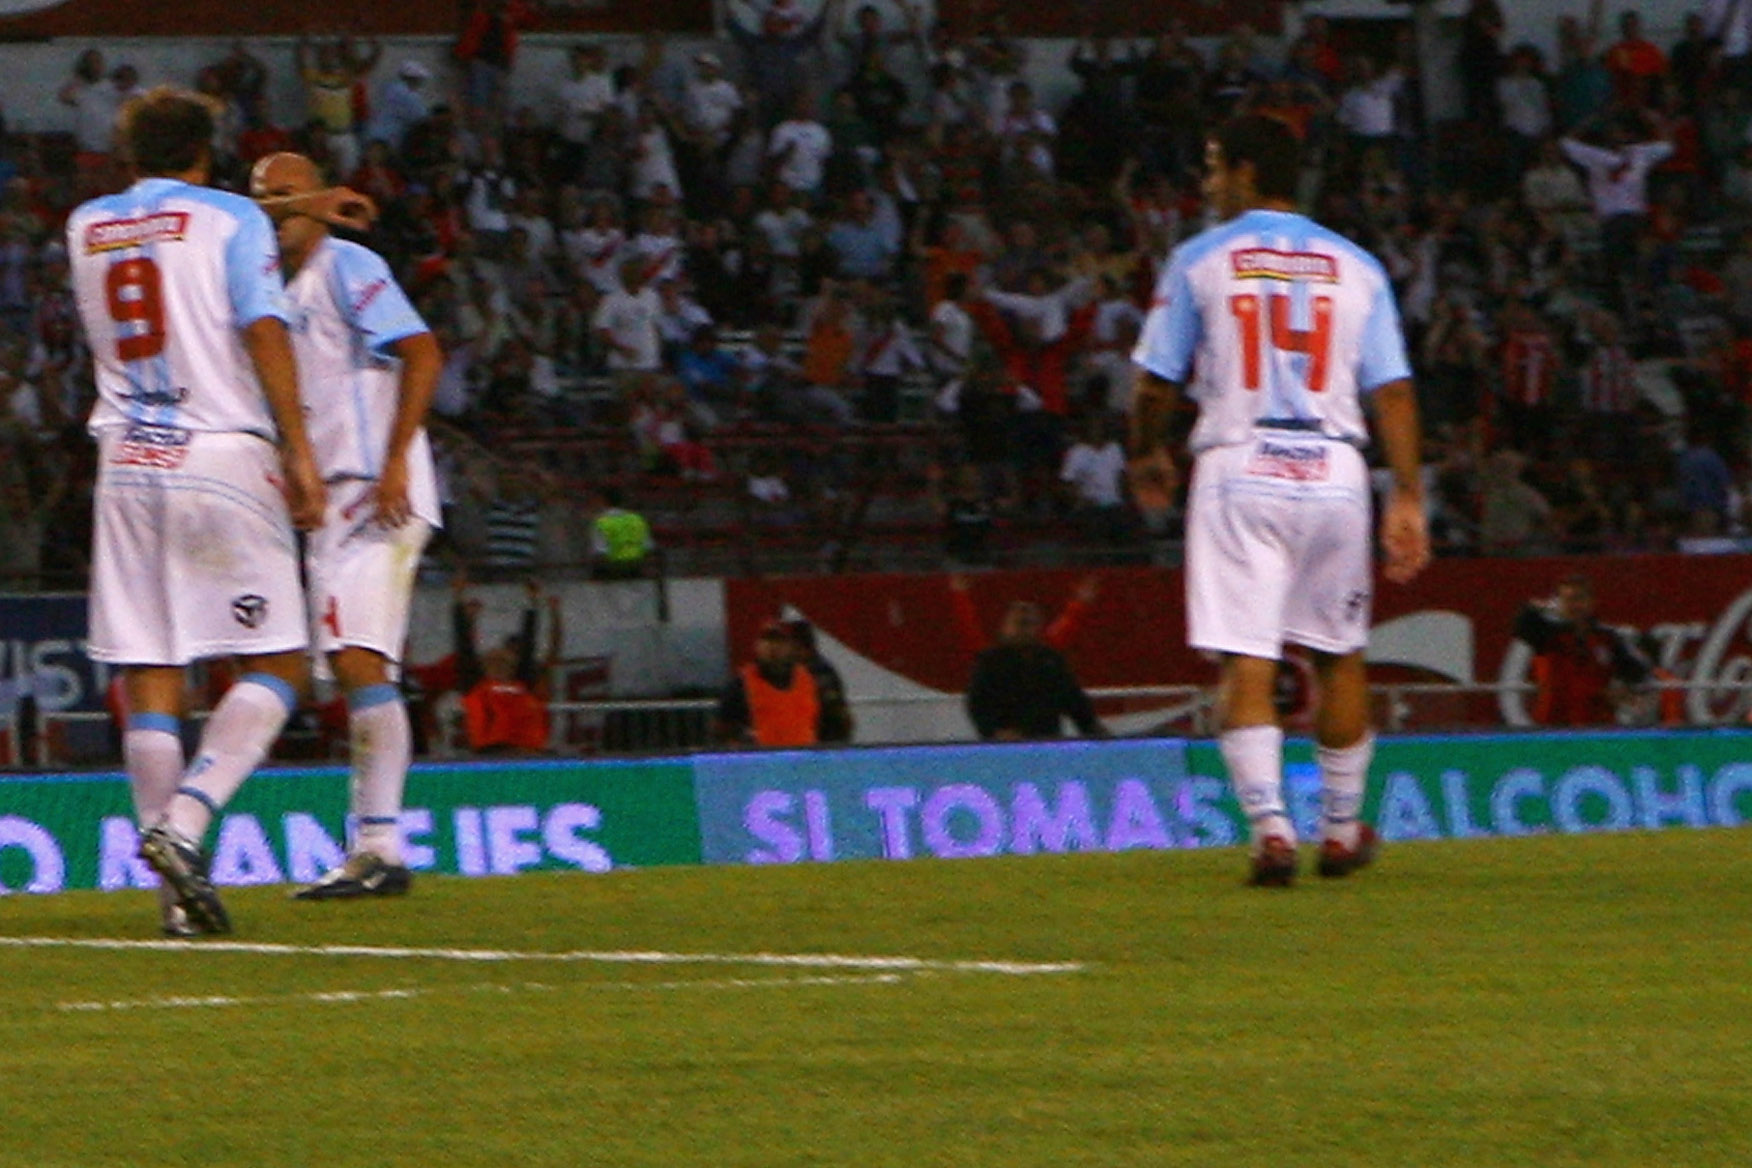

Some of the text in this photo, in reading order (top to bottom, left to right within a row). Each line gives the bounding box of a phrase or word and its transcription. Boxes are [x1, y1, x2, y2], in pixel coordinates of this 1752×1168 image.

[107, 257, 166, 362] 9
[1231, 293, 1332, 393] 14
[743, 789, 836, 866] SI
